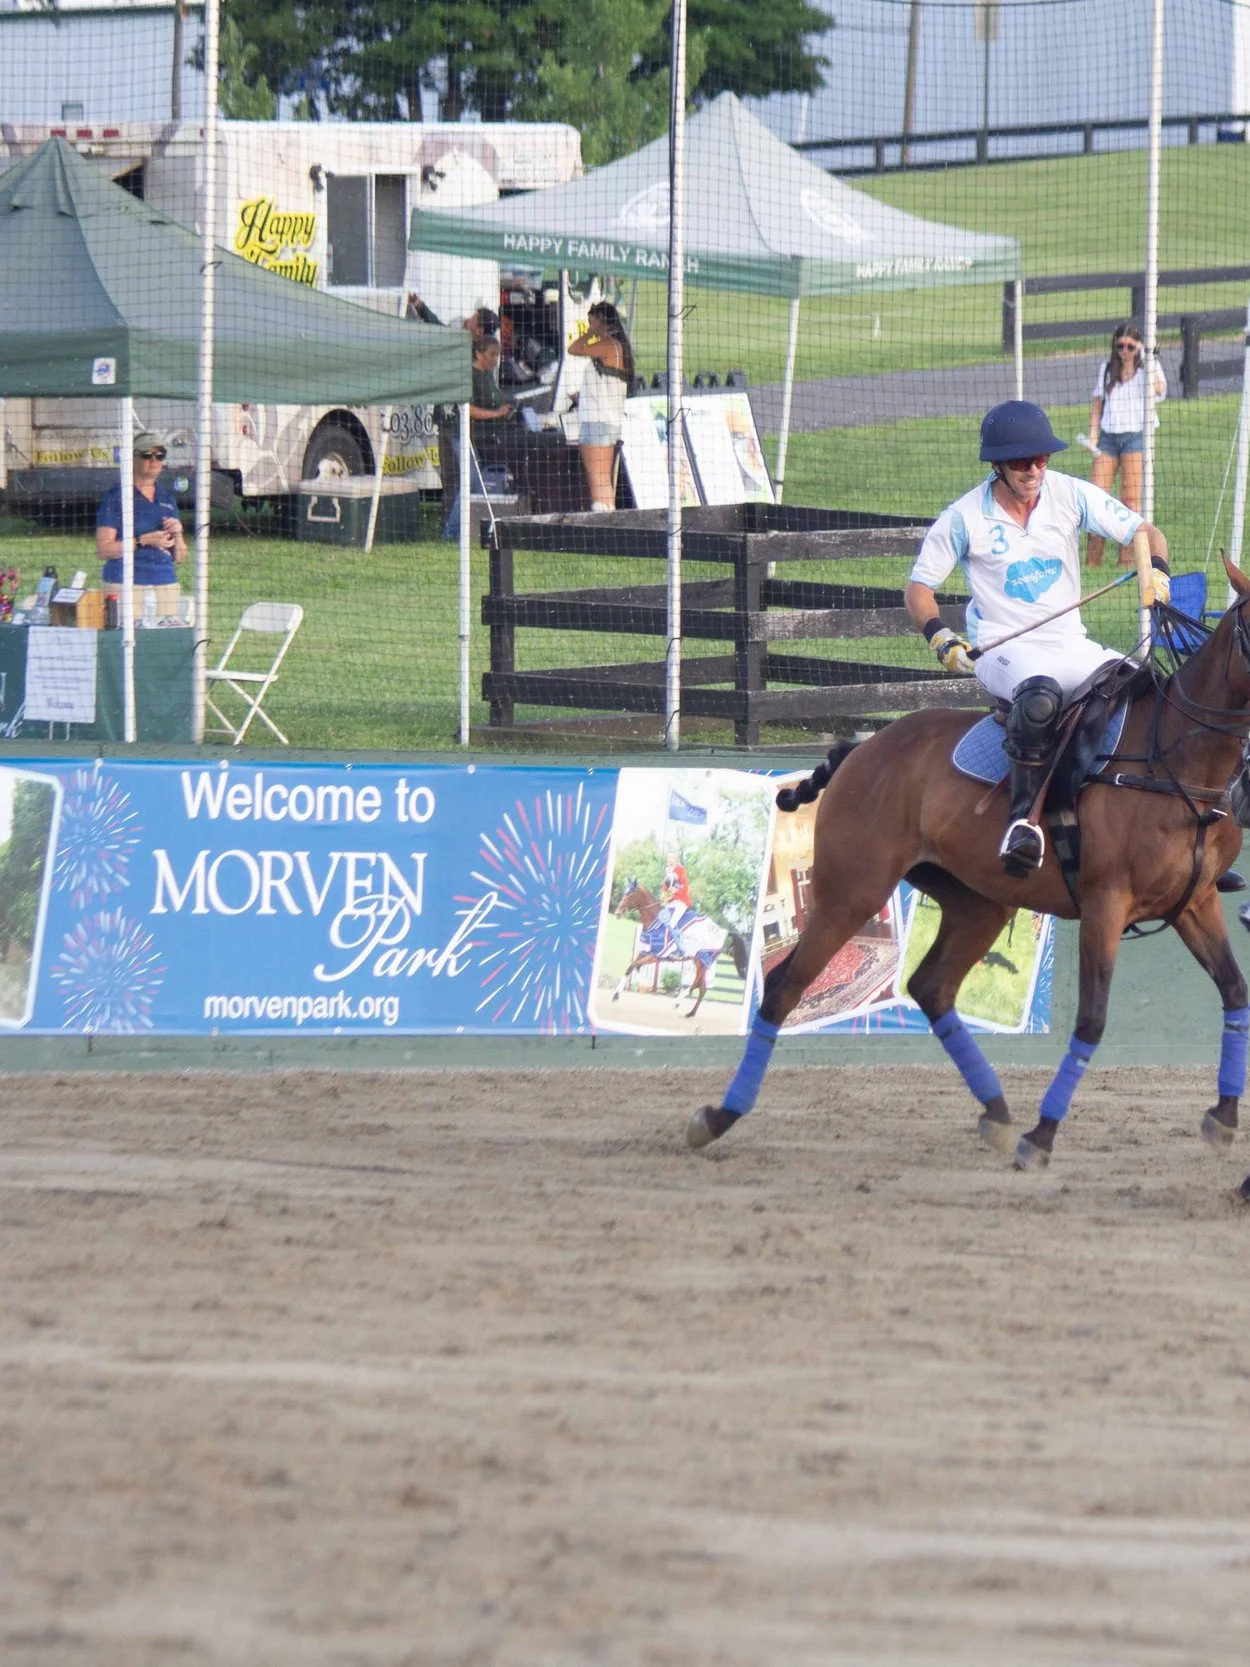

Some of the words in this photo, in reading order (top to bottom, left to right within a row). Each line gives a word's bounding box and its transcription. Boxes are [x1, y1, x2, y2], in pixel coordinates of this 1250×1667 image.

[237, 199, 316, 246] Happy
[503, 233, 563, 255] HAPPY
[567, 239, 631, 263] FAMILY
[635, 249, 700, 273] RANH
[856, 261, 893, 278] HAPPY
[989, 524, 1010, 555] 3
[180, 771, 382, 823] Welcome
[394, 778, 436, 824] to
[150, 848, 429, 917] MORVEN
[313, 891, 498, 982] Park
[203, 990, 400, 1027] morvenpark.org
